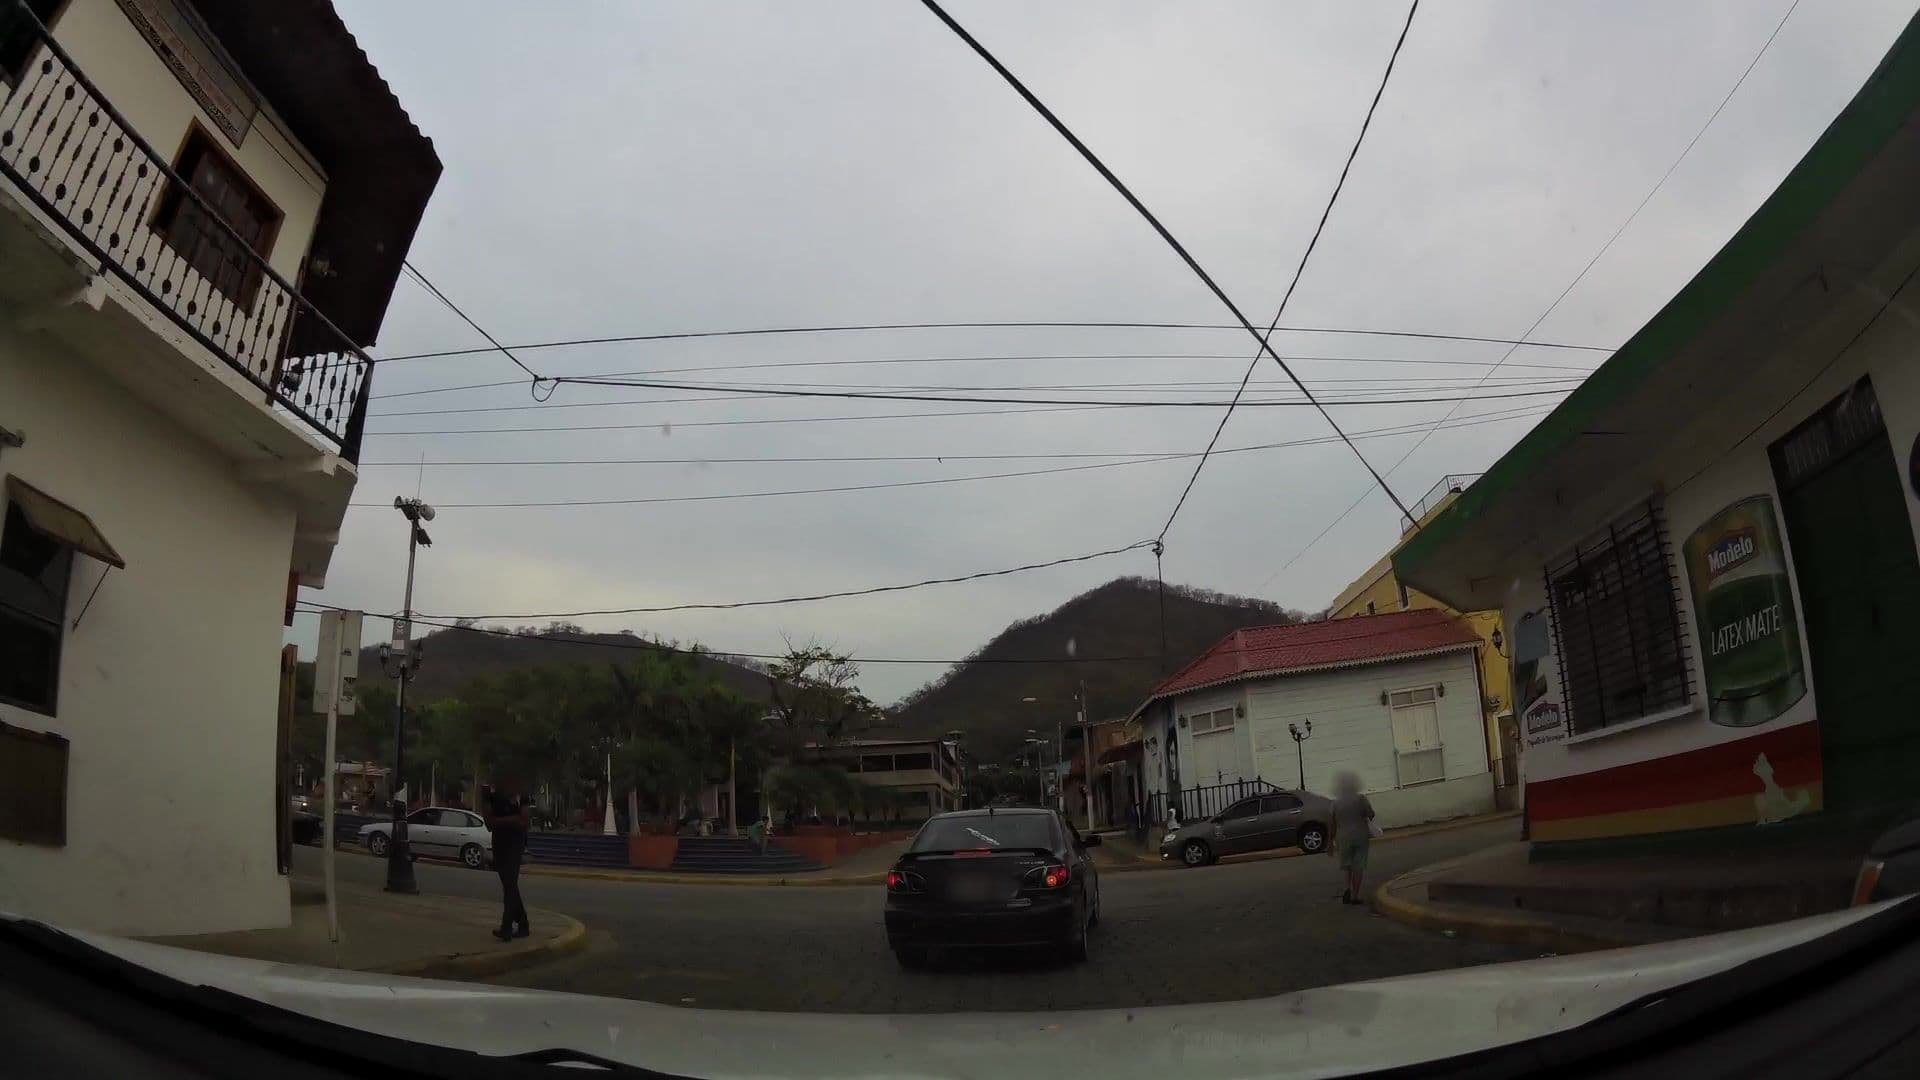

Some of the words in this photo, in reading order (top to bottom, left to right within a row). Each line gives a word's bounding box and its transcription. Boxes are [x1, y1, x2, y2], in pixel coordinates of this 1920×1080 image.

[1708, 536, 1753, 572] Modelo
[1711, 622, 1744, 656] LATEX
[1745, 604, 1782, 642] MATE
